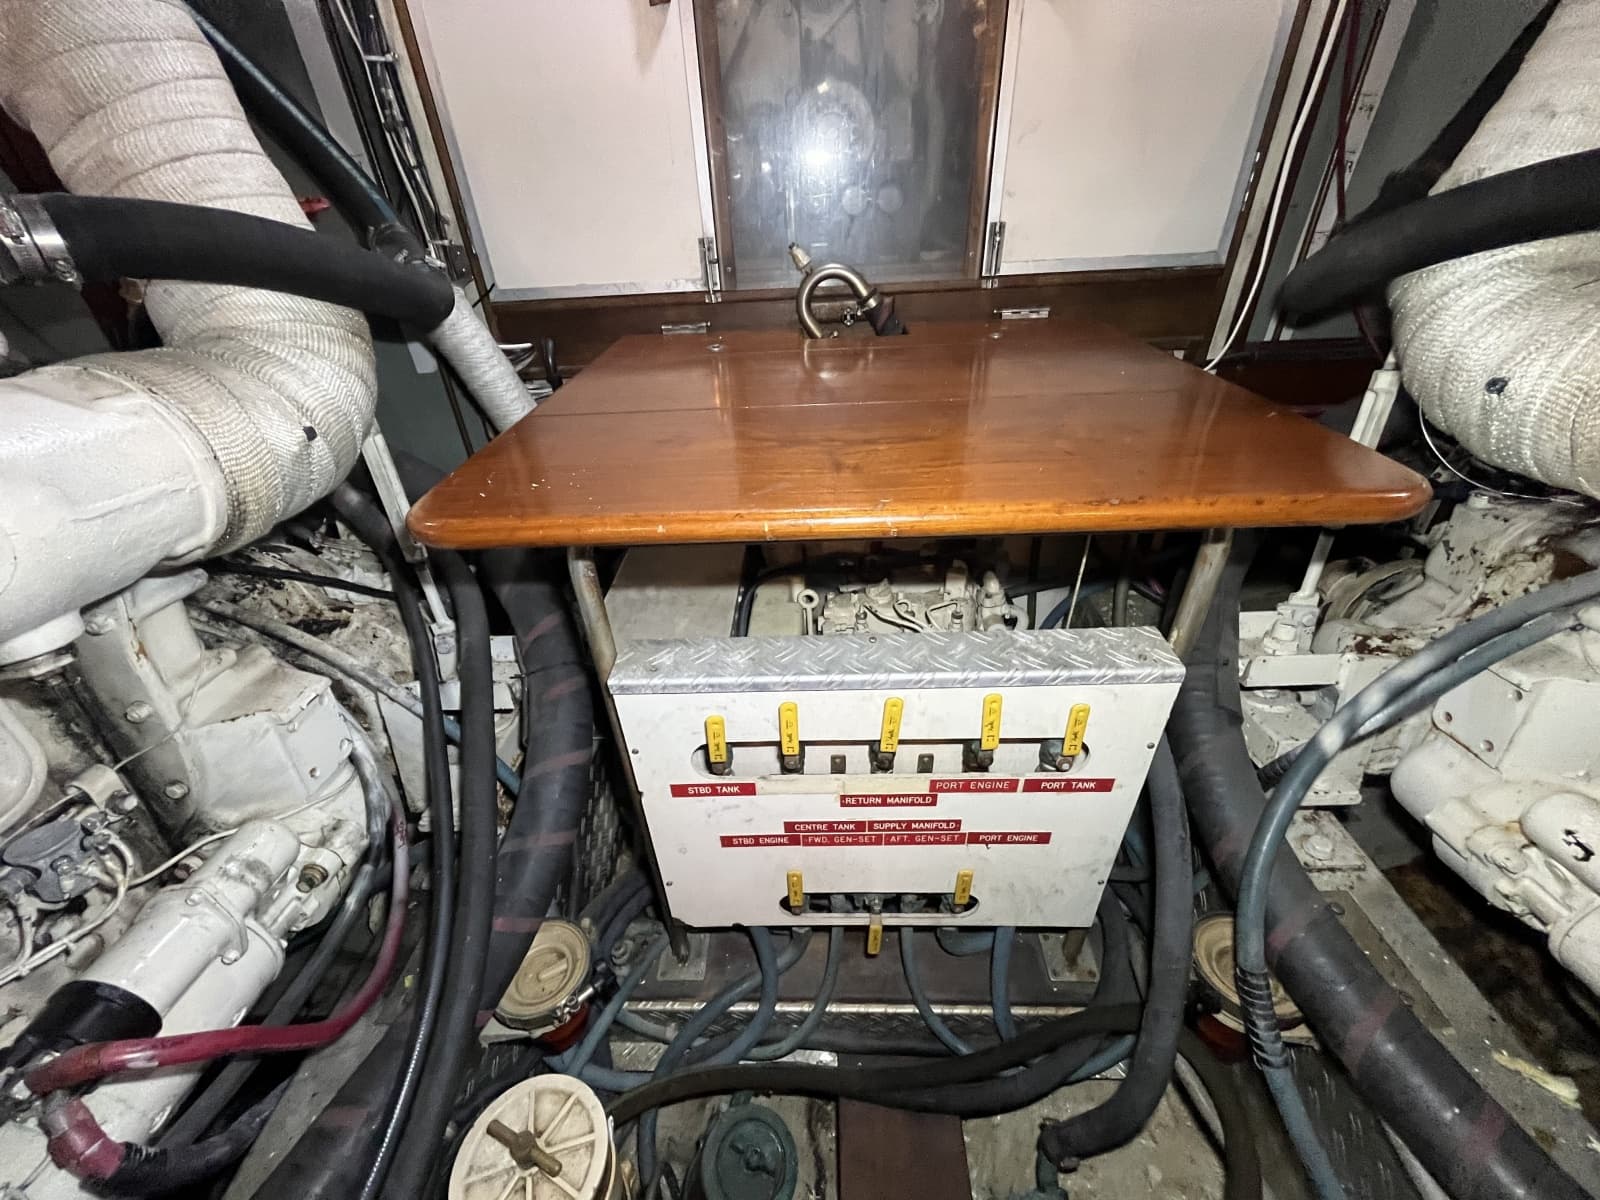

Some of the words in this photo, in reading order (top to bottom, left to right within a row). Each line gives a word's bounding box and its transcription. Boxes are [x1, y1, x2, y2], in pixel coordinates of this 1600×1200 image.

[687, 786, 712, 795] STBD
[716, 785, 741, 794] TANK
[936, 781, 964, 790] PORT
[970, 781, 1010, 790] ENGINE
[1041, 781, 1066, 790] PORT
[1071, 781, 1097, 790] TANK
[845, 796, 882, 805] RETURN
[887, 795, 932, 804] MANIFOLD
[794, 823, 829, 832] CENTRE
[833, 822, 856, 831] TANK
[873, 822, 906, 831] SUPPLY
[911, 821, 956, 830] MANIFOLD
[732, 837, 755, 846] STBD
[759, 836, 790, 845] ENGINE
[808, 836, 829, 845] FWD.
[833, 834, 876, 844] GEN-SET
[890, 835, 911, 843] AFT.
[915, 834, 959, 843] GEN-SET
[979, 834, 1002, 842] PORT
[1007, 833, 1038, 842] ENGINE
